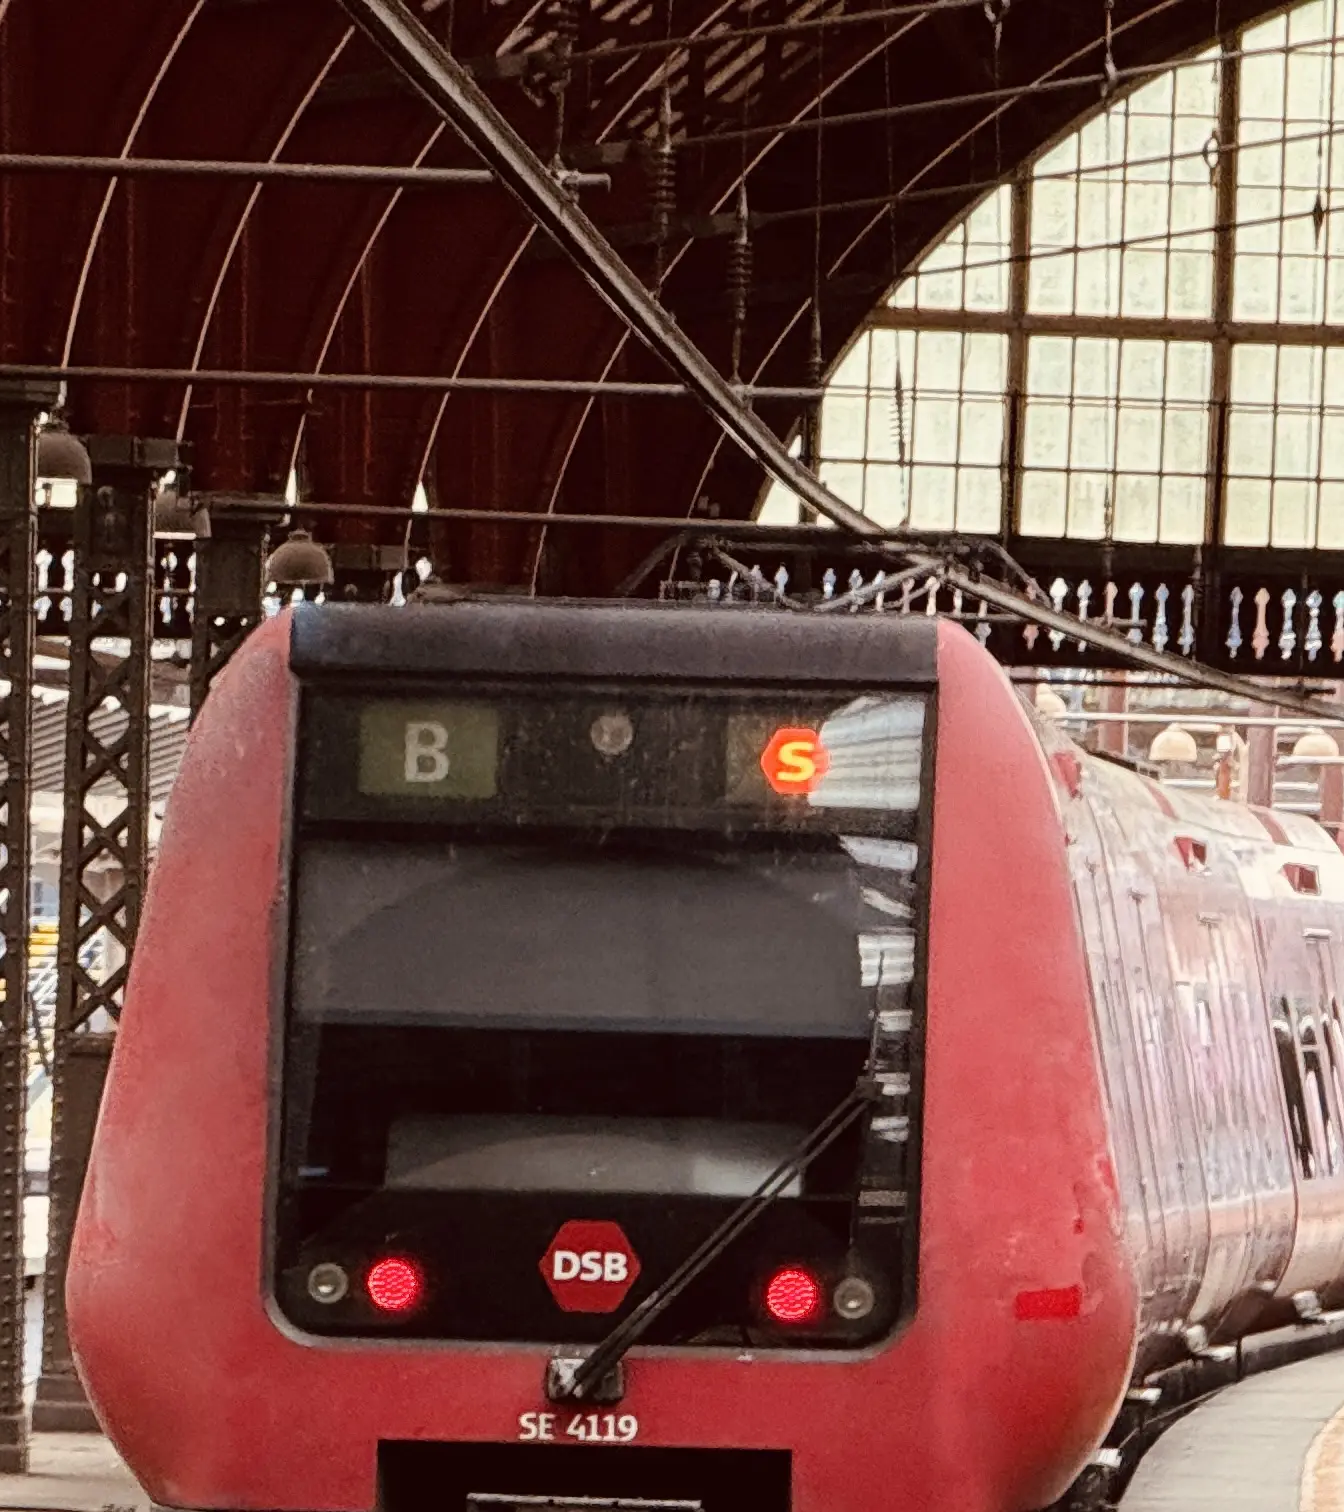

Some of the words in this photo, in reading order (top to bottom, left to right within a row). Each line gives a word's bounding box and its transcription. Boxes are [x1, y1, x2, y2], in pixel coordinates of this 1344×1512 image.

[405, 722, 449, 782] B
[777, 741, 815, 782] S
[553, 1250, 628, 1281] DSB
[518, 1412, 556, 1441] SE
[567, 1413, 638, 1442] 4119
